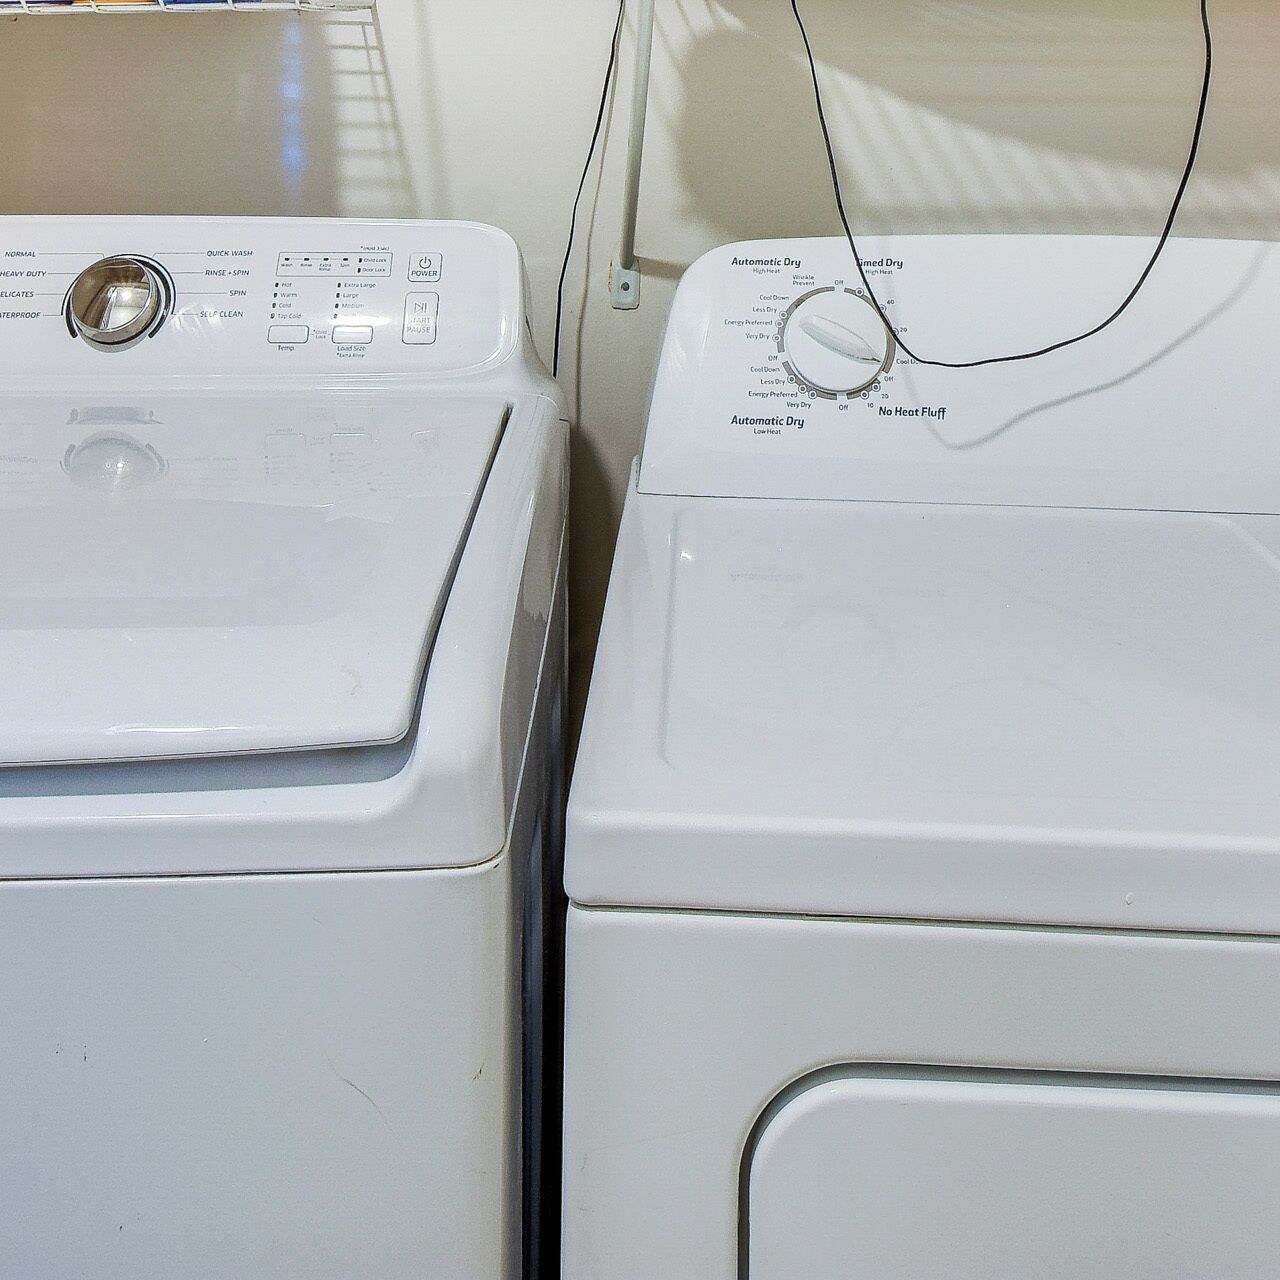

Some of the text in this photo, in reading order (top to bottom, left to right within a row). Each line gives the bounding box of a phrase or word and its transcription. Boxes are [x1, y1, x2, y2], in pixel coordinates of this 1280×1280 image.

[731, 257, 801, 268] Automatic Dry
[885, 259, 904, 269] Dry
[360, 282, 376, 290] Large
[745, 332, 759, 340] Very
[879, 406, 947, 420] No Heat Fluff
[731, 414, 805, 429] Automatic Dry
